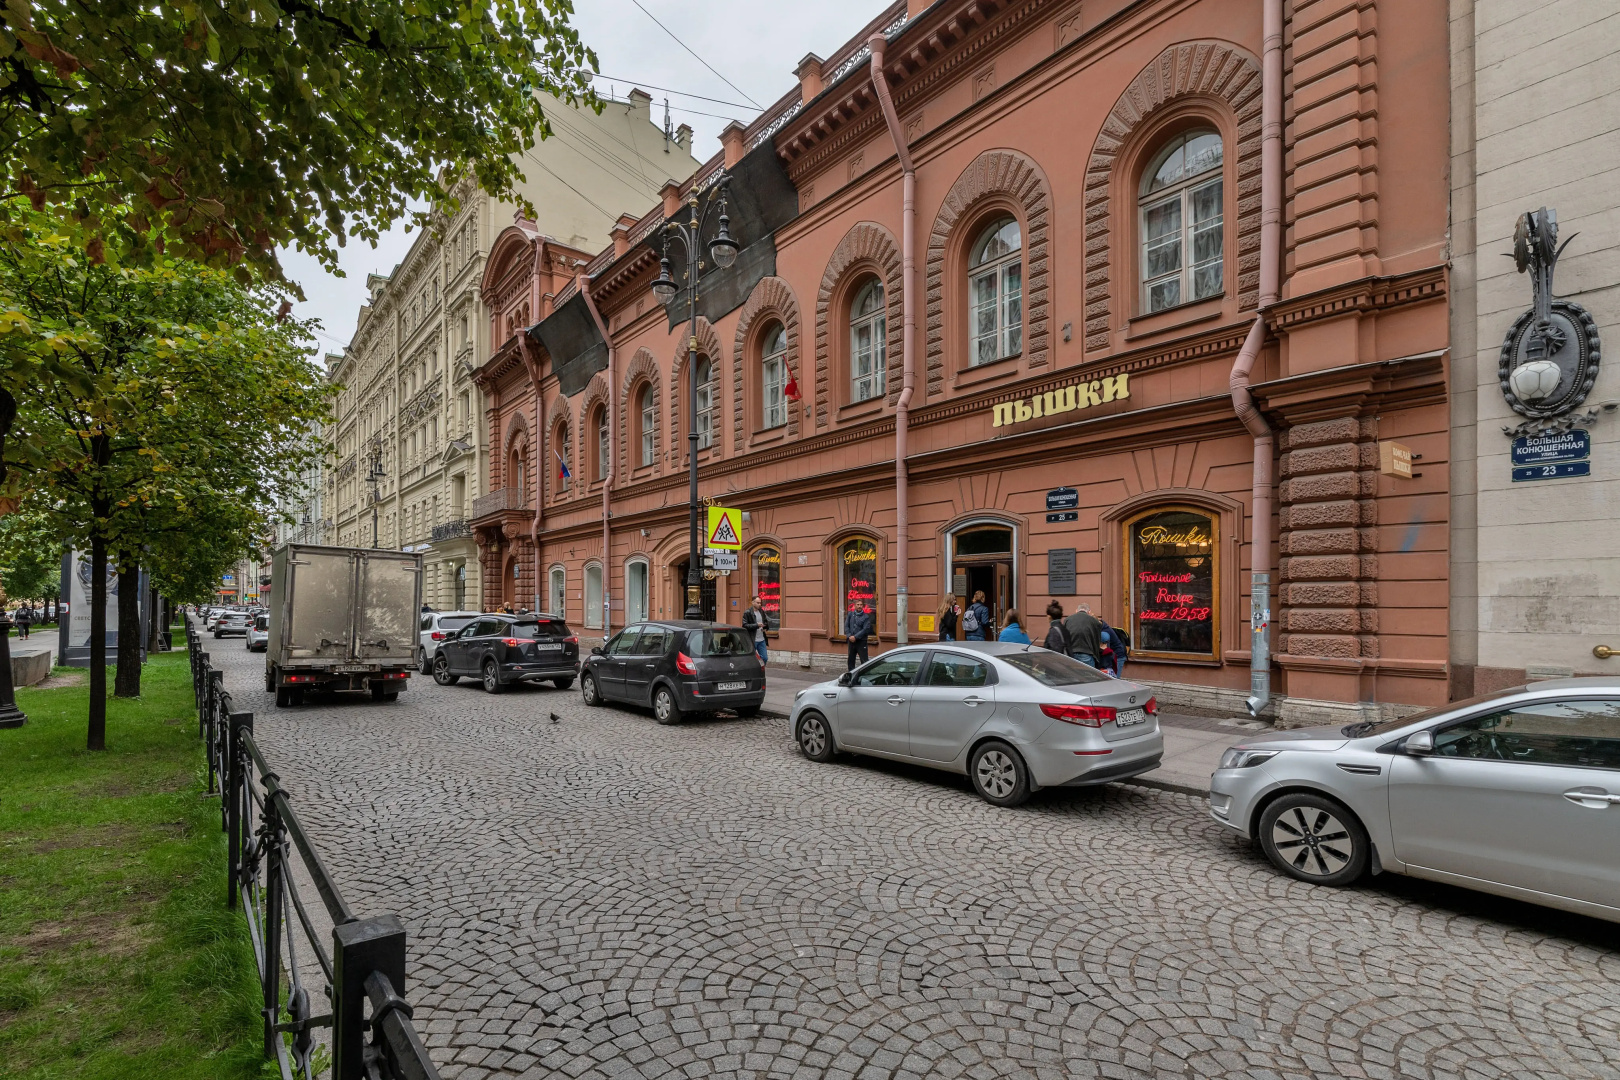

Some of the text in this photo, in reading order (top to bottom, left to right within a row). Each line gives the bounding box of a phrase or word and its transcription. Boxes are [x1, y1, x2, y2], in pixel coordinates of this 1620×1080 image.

[992, 373, 1130, 428] ПЫШКИ
[1526, 434, 1574, 447] БОЛЬШАЯ
[1516, 441, 1585, 455] КОНЮШЕННАЯ
[1542, 465, 1557, 476] 23
[1156, 587, 1194, 607] Recipe
[1139, 607, 1211, 621] since 1958
